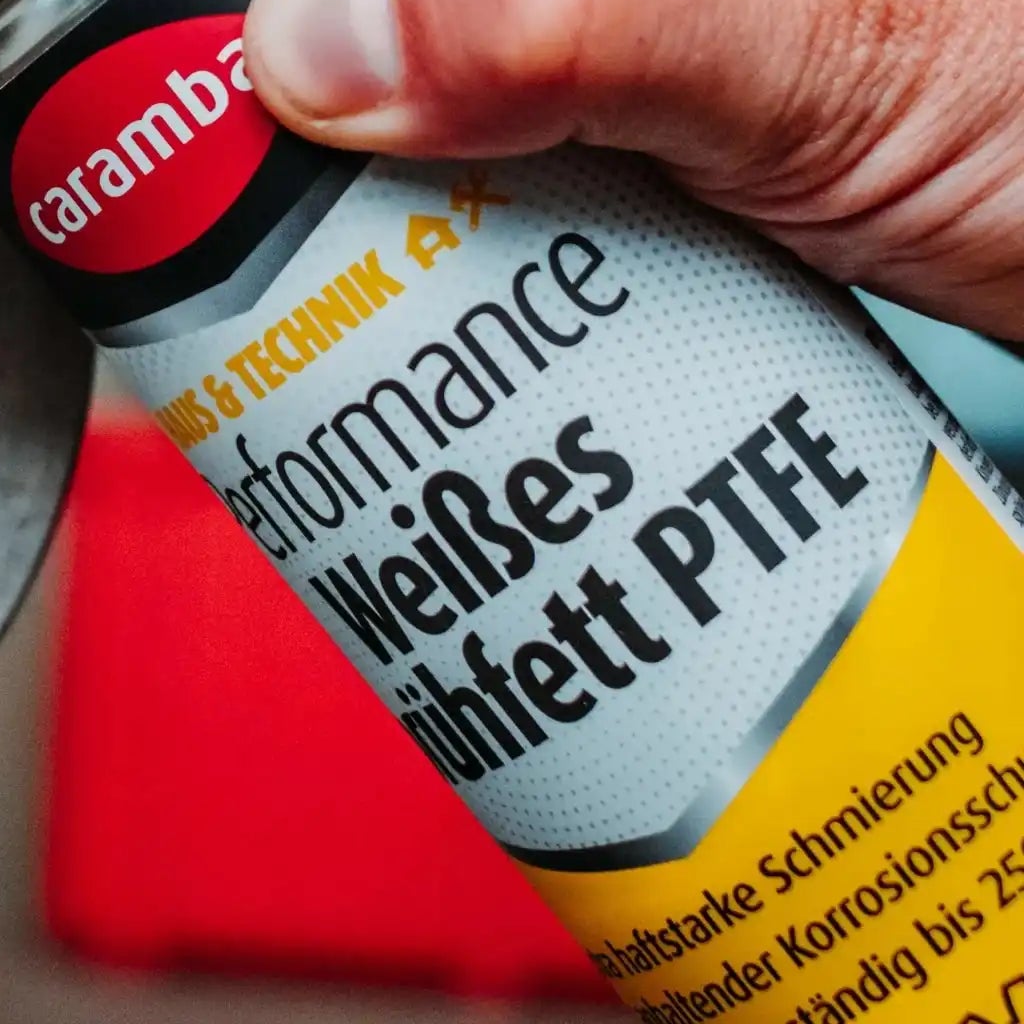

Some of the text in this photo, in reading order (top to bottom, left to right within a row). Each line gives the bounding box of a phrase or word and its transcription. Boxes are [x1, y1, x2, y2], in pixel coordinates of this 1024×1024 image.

[199, 232, 630, 560] erformance
[202, 375, 245, 419] &
[225, 249, 405, 400] TECHNIK
[308, 415, 634, 666] Weißes
[632, 393, 869, 626] PTFE
[603, 879, 764, 977] haftstarke
[757, 711, 986, 895] Schmierung
[911, 898, 985, 957] bis
[977, 834, 1024, 909] 25
